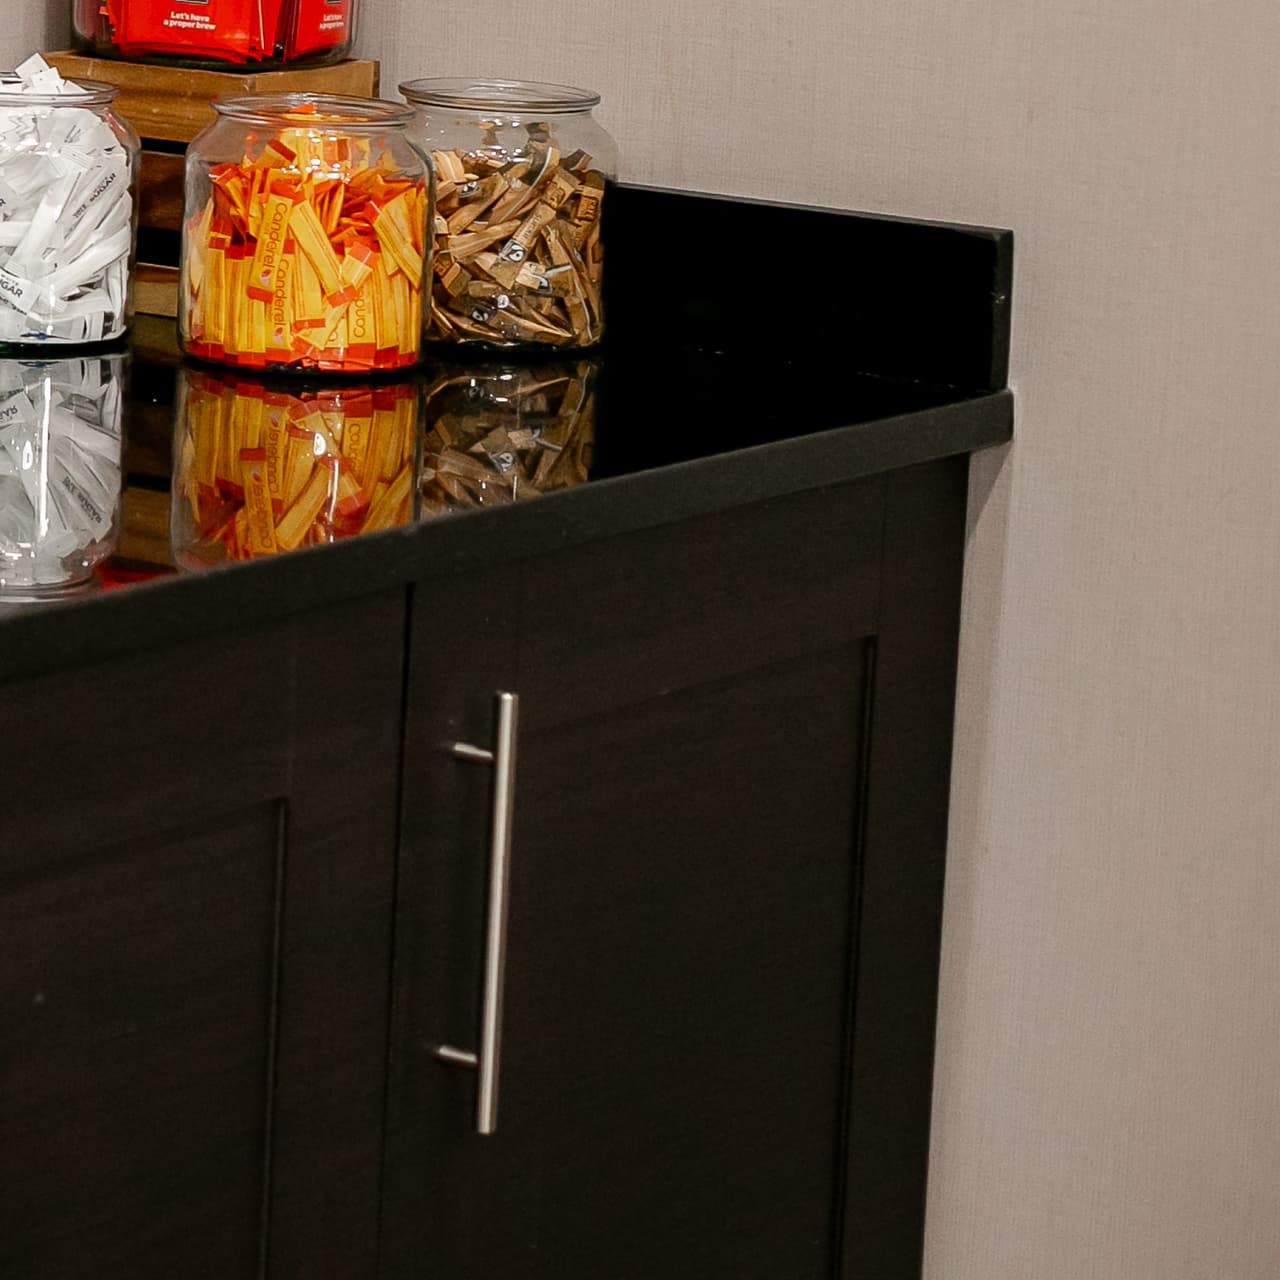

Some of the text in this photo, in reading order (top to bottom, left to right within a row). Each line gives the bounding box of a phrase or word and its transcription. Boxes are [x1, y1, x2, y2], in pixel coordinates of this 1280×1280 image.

[168, 19, 197, 29] proper
[195, 22, 217, 31] brew
[170, 11, 211, 23] Let's have
[263, 202, 288, 269] Canderel
[274, 258, 290, 326] Canderel
